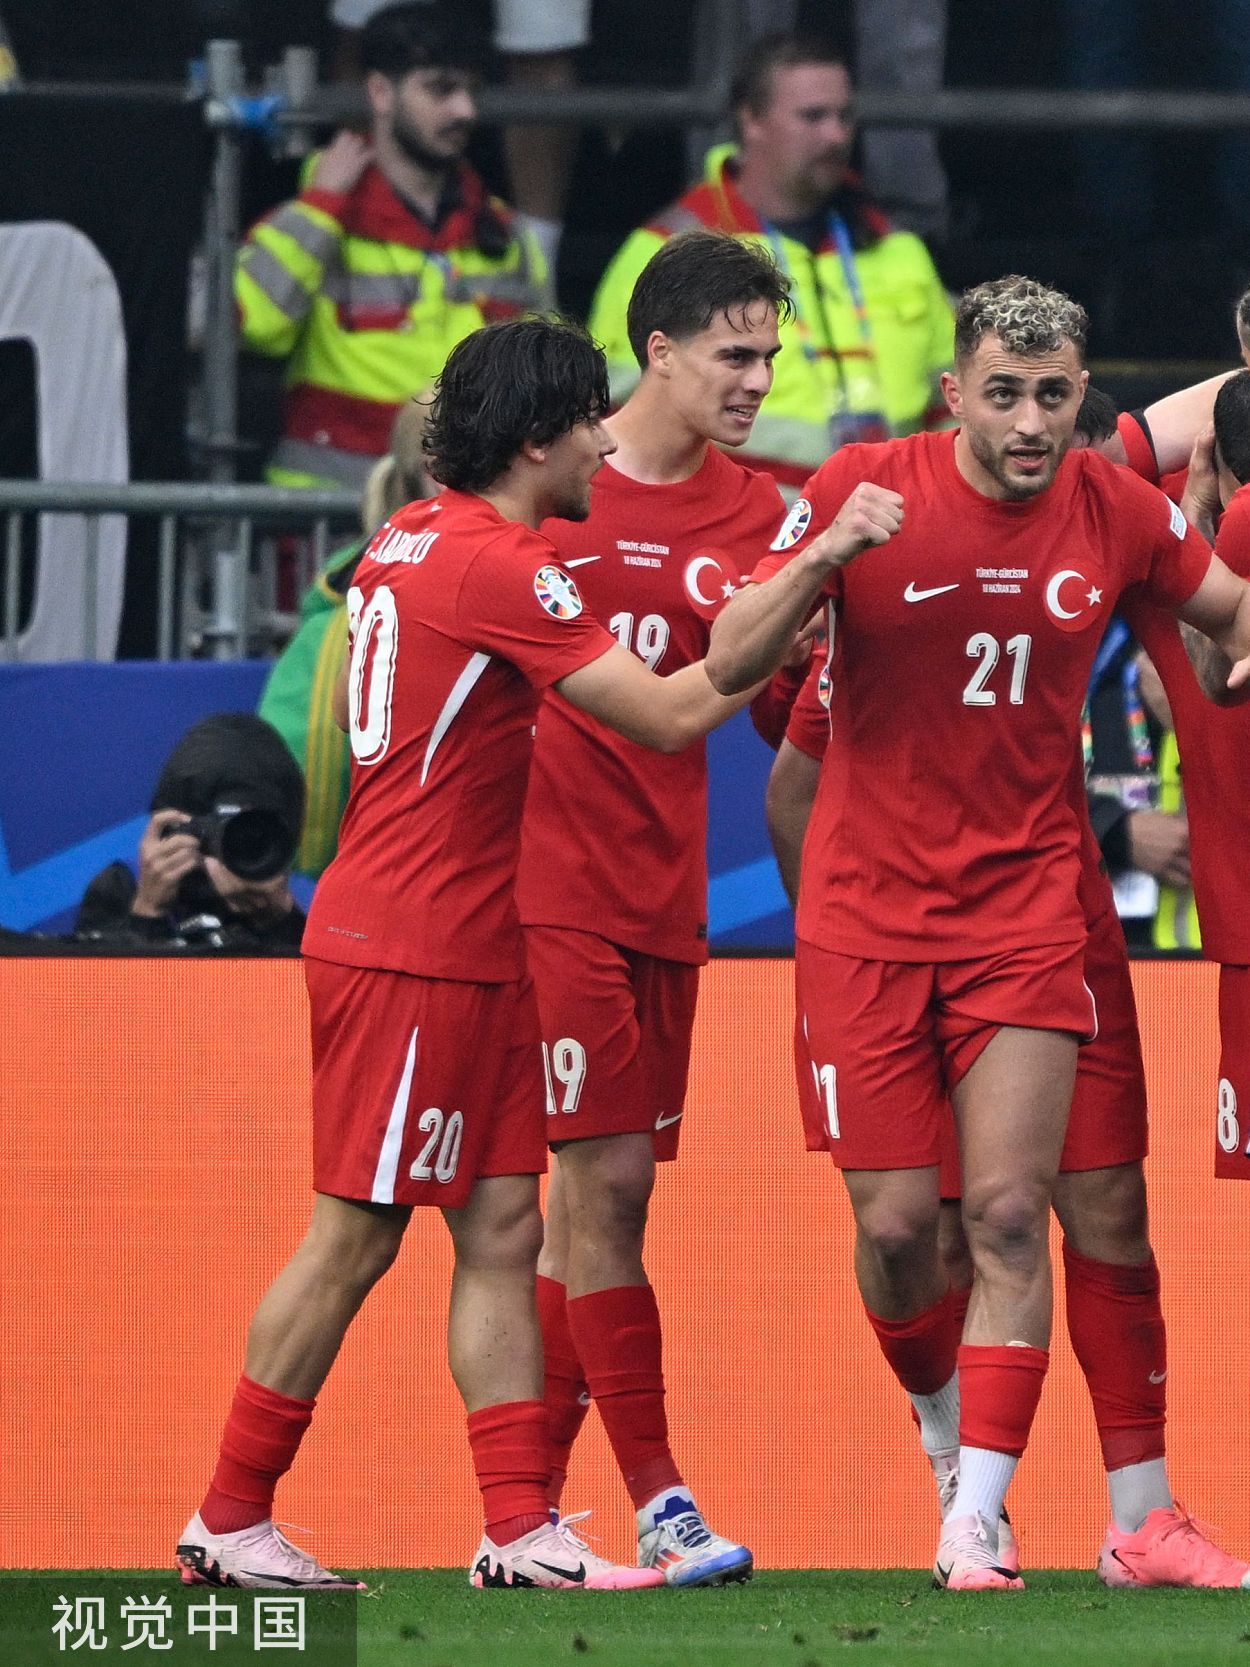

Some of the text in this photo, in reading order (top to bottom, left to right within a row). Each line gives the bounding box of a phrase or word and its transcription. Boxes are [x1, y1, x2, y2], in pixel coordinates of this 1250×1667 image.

[609, 611, 671, 673] 19
[963, 632, 1032, 706] 21
[409, 1107, 464, 1184] 20
[1217, 1078, 1240, 1153] 8
